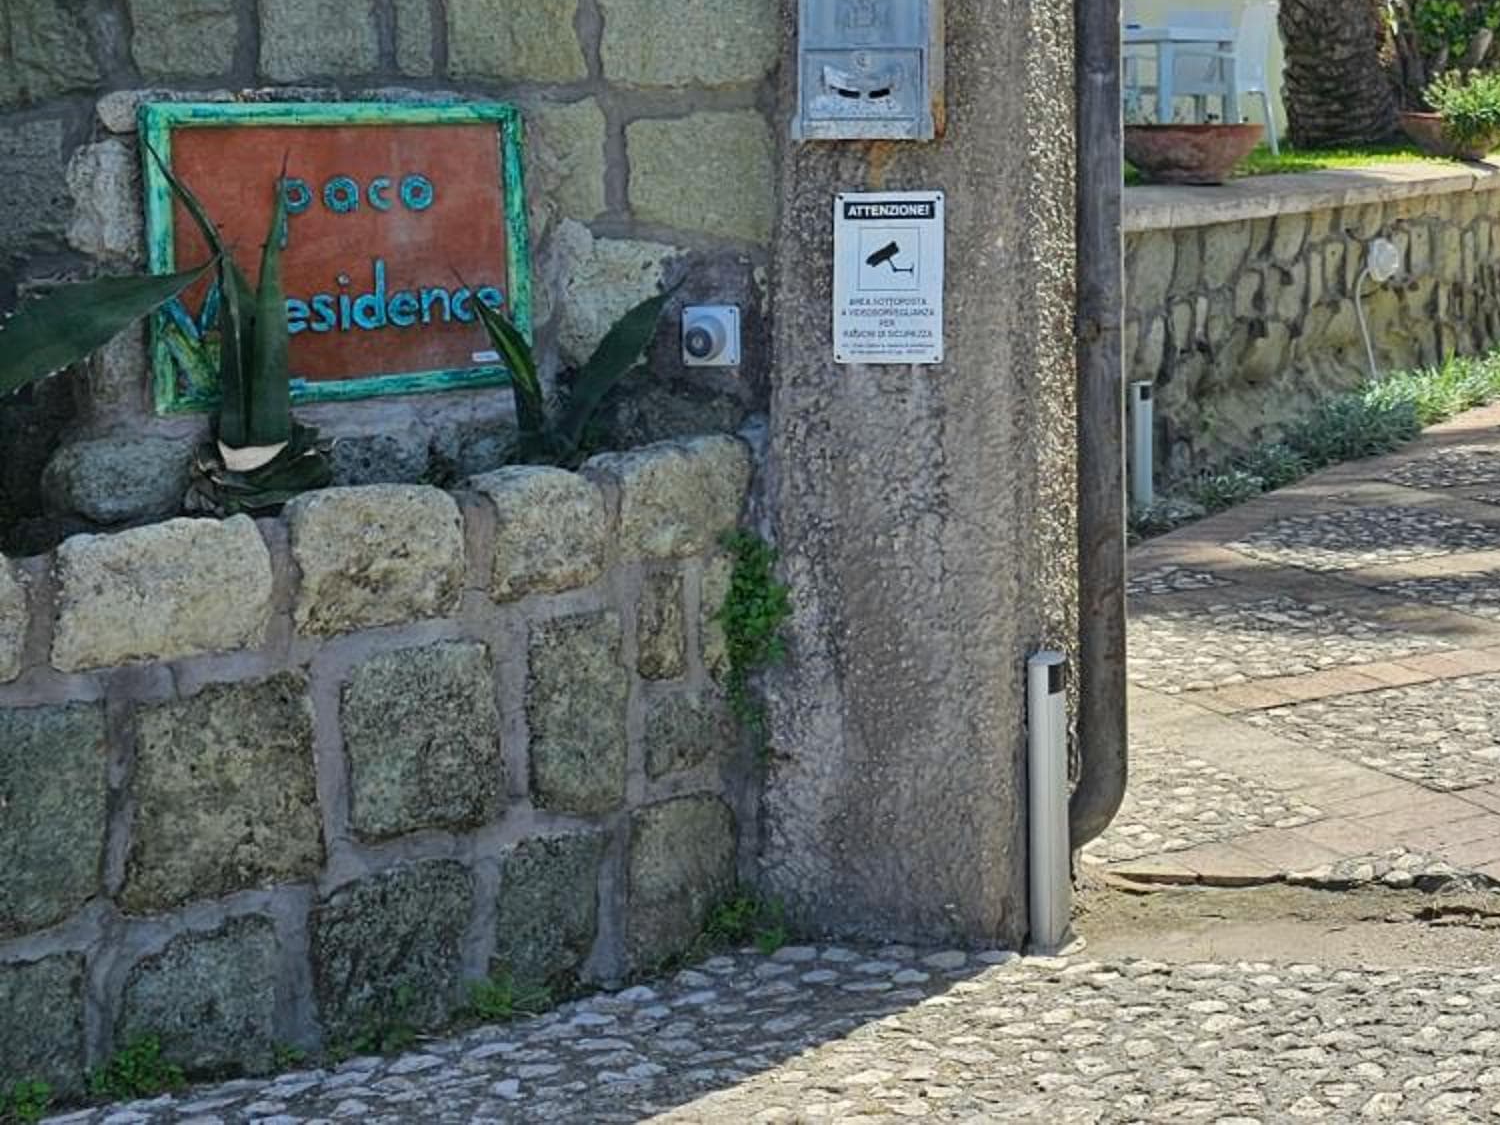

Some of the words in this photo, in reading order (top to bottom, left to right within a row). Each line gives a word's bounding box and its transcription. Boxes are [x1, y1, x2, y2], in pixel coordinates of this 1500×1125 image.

[278, 174, 435, 249] paco
[848, 204, 930, 216] ATTENZIONE!
[284, 258, 503, 334] esidence
